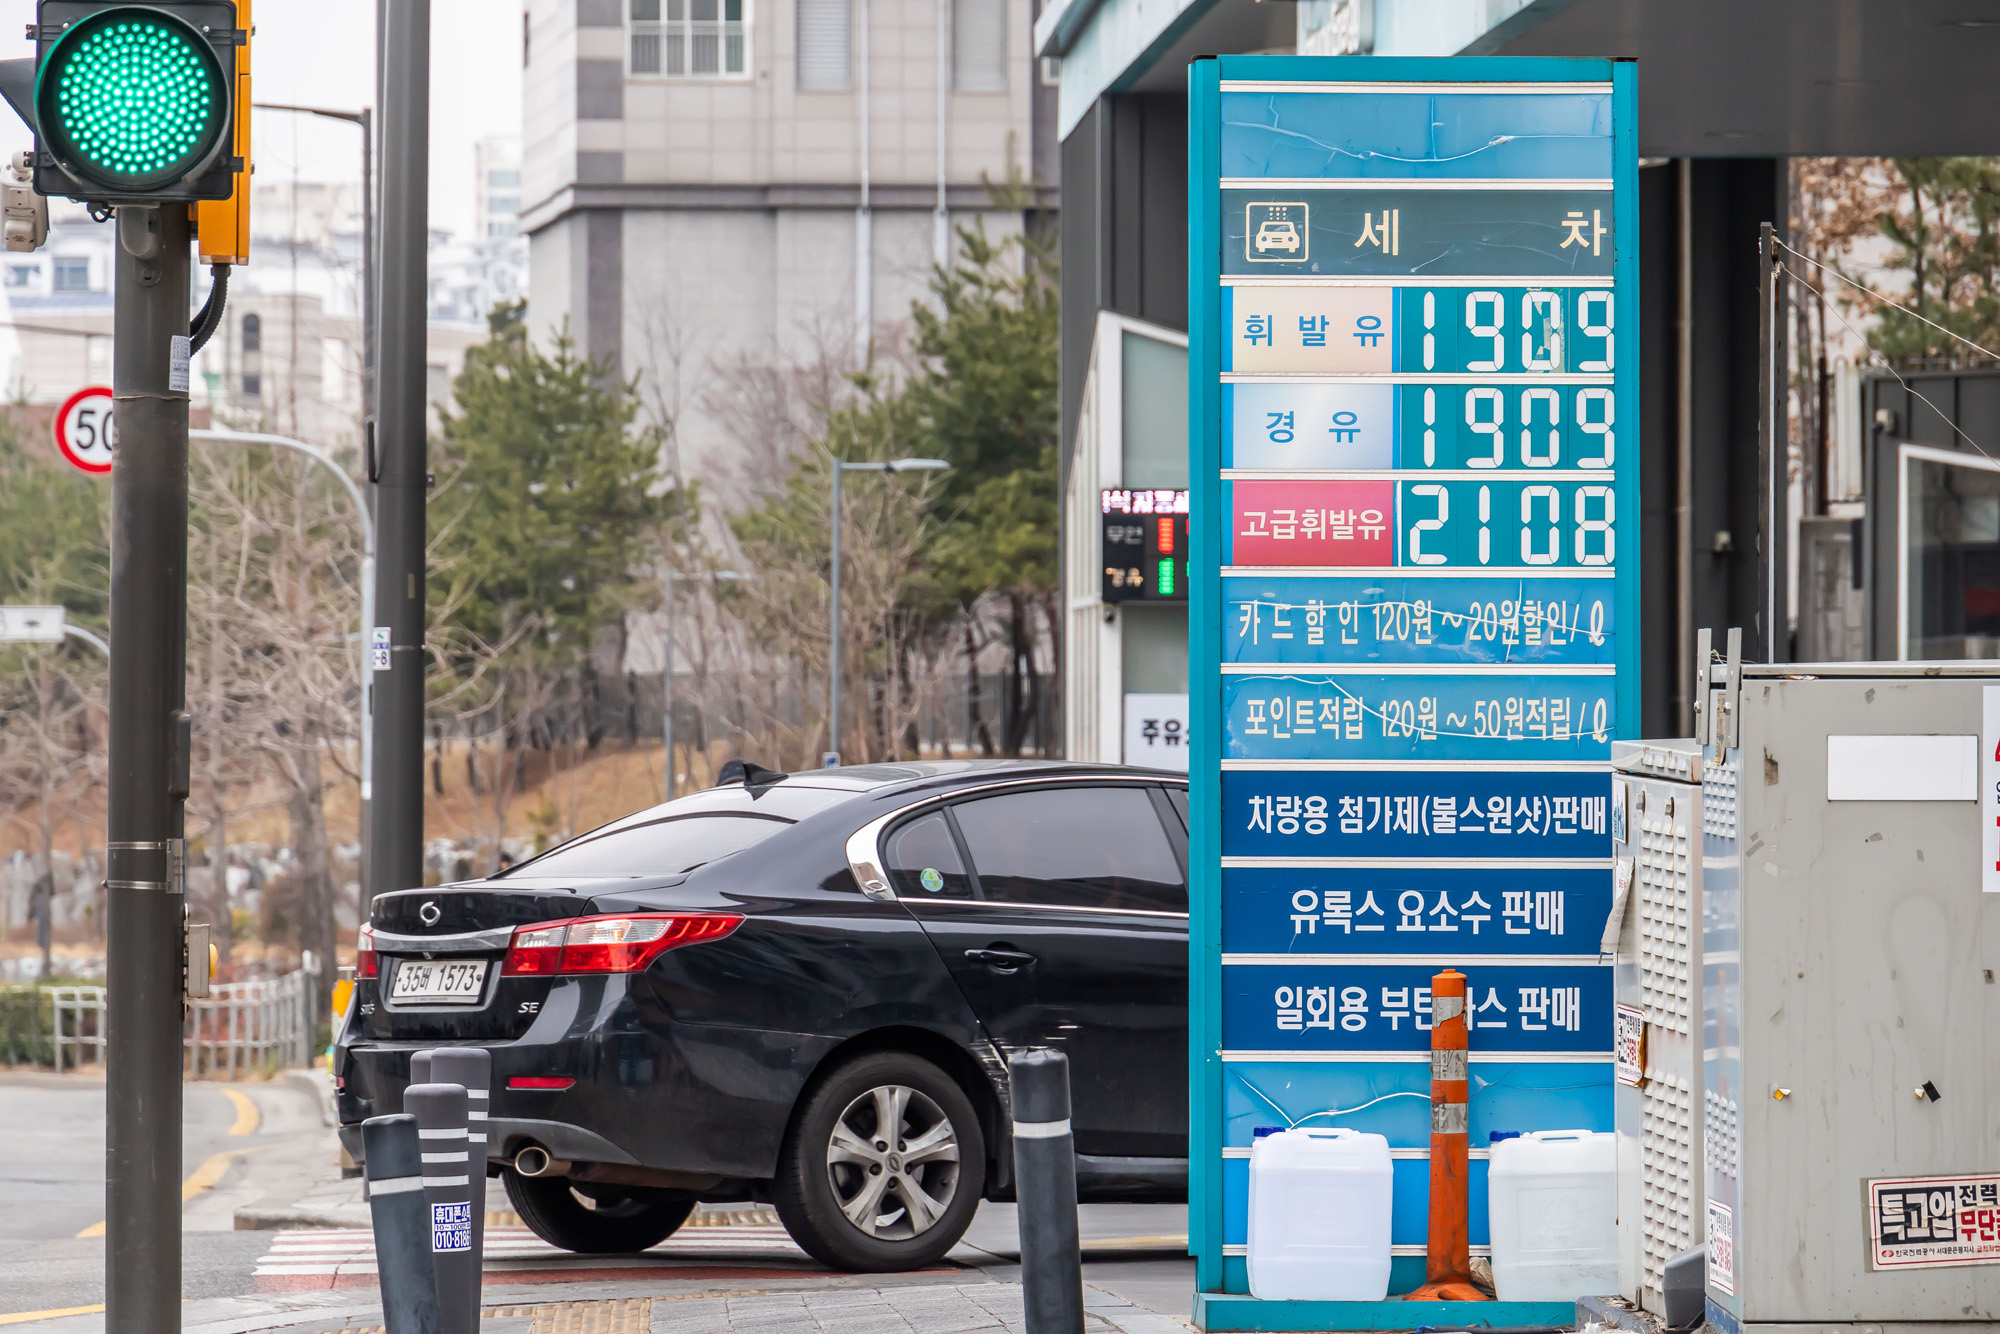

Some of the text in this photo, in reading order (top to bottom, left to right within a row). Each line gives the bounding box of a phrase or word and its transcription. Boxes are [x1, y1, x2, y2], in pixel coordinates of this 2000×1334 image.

[1423, 291, 1614, 371] 1909
[1423, 387, 1614, 468] 1909
[1240, 509, 1386, 540] 고급휘발유
[1409, 484, 1614, 565] 2108
[1142, 719, 1189, 746] 주유
[1245, 697, 1364, 740] 포인트적립
[1247, 796, 1328, 834] 차량용
[1290, 890, 1564, 935] 유록스 요소수 판매
[437, 965, 477, 991] 1573
[518, 1002, 540, 1013] SE
[1275, 986, 1369, 1031] 일회용
[1380, 986, 1507, 1031] 부탄스
[1518, 986, 1580, 1031] 판매
[1881, 1191, 1955, 1240] 특고압
[1959, 1184, 1998, 1207] 전력
